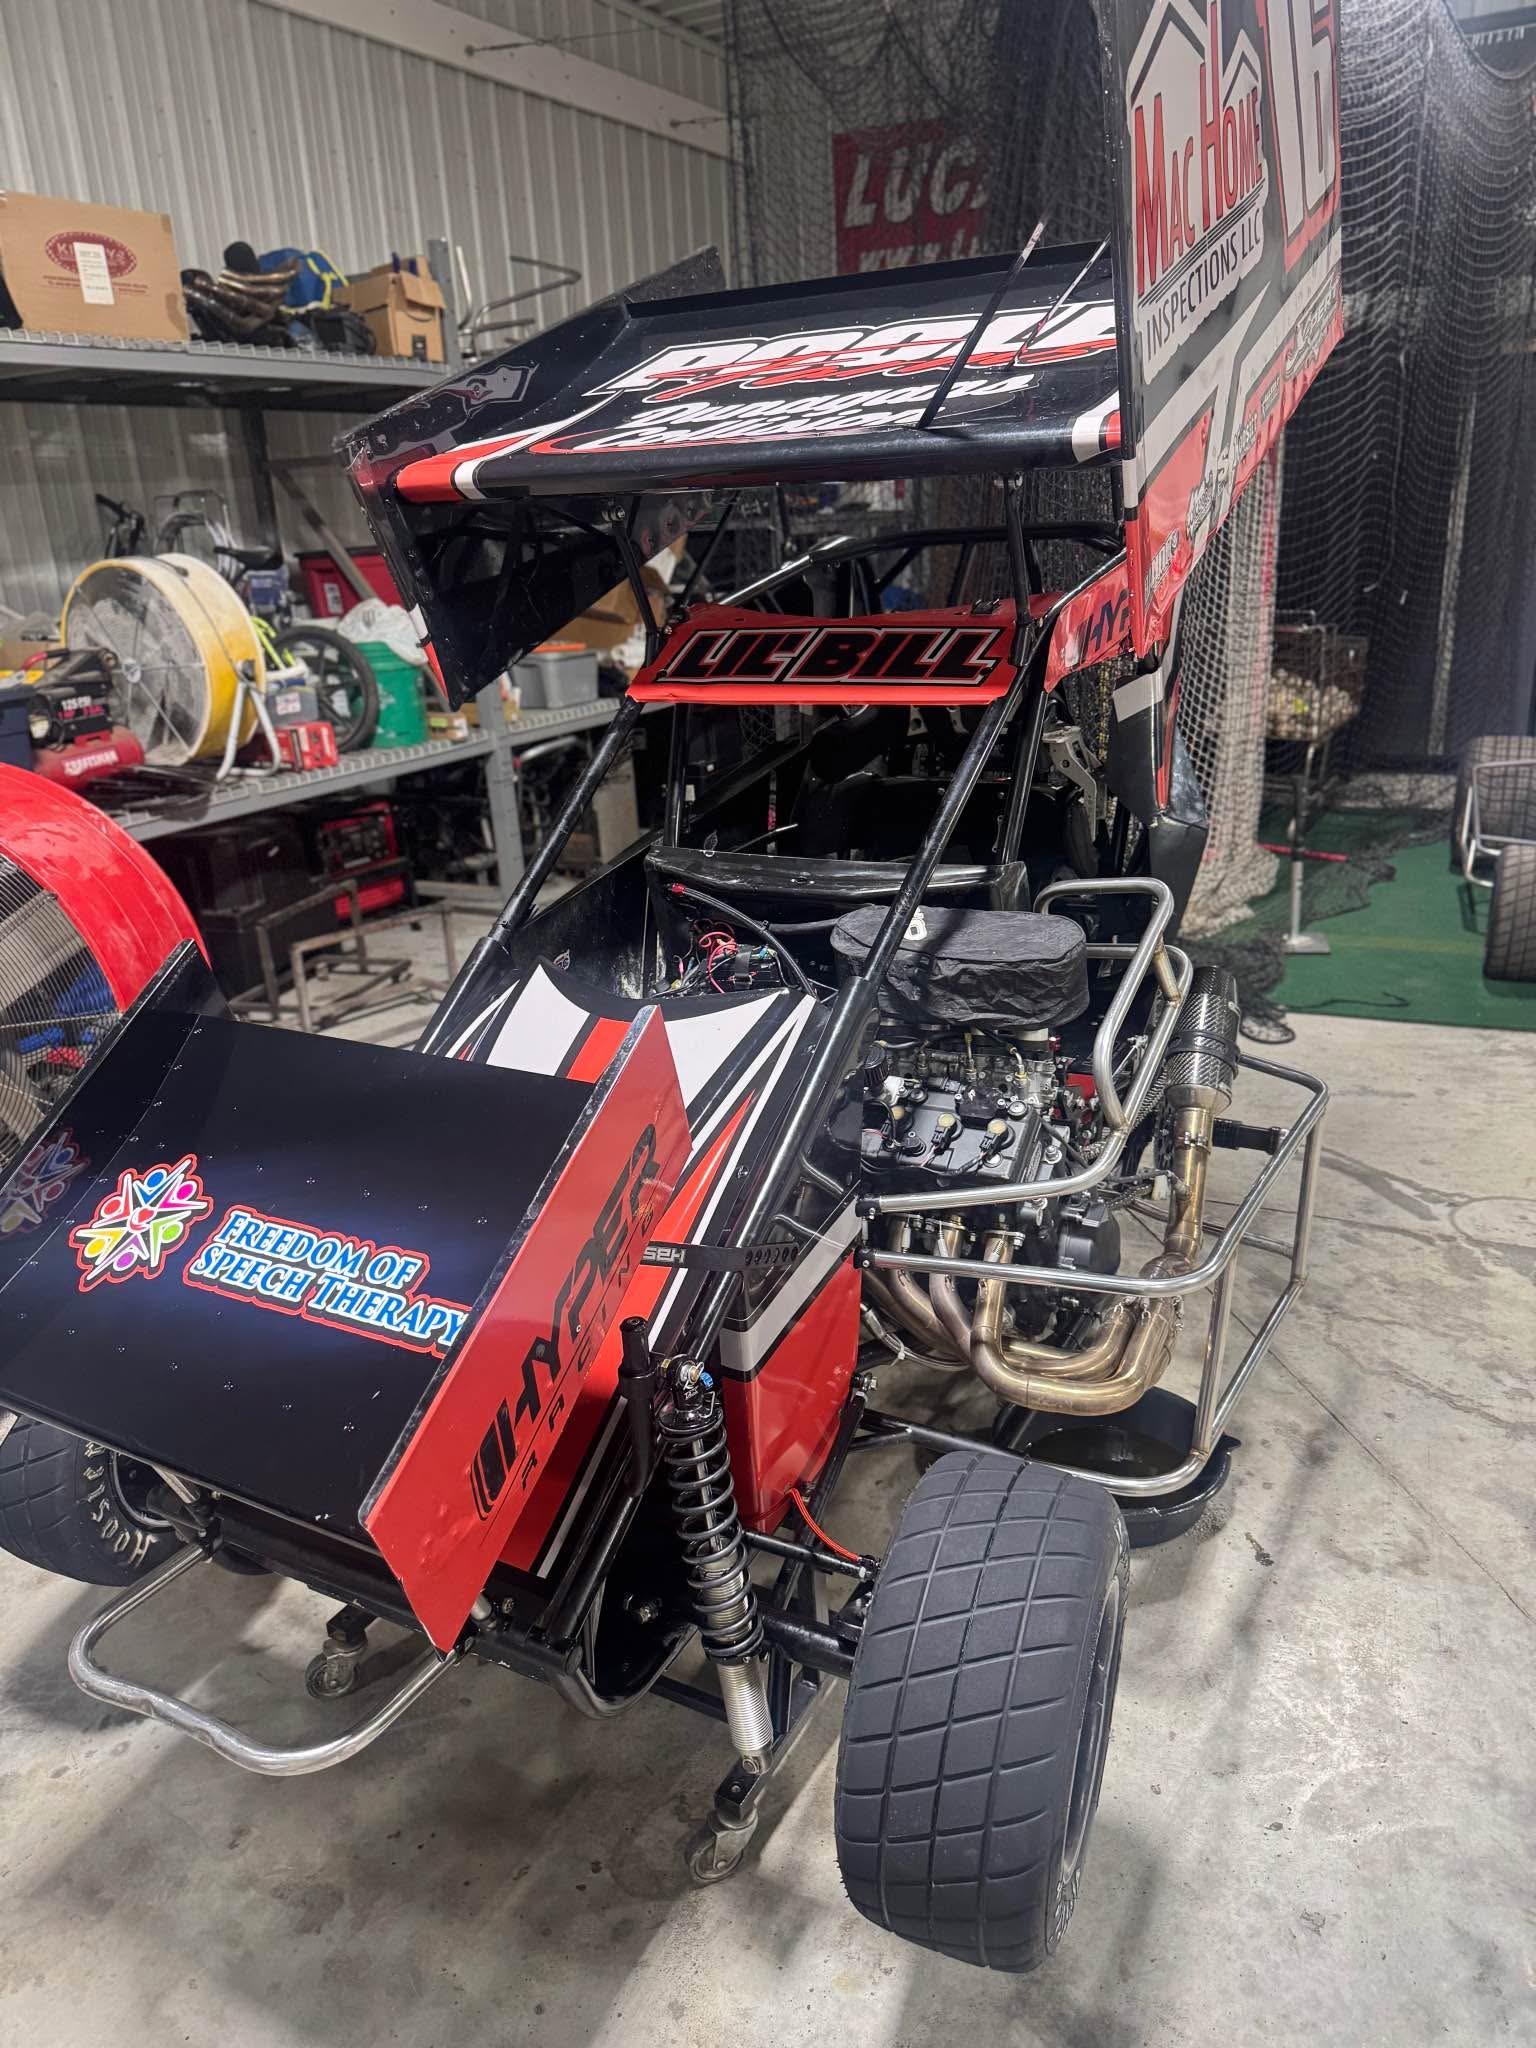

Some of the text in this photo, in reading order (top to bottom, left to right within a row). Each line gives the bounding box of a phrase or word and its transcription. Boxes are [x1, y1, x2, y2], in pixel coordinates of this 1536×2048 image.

[1146, 208, 1261, 362] INSPECTIONS LLC
[572, 405, 946, 451] Collision
[784, 628, 1000, 684] BILL
[195, 1243, 468, 1346] SPEECH THERAPY
[214, 1211, 423, 1290] FREEDOM OF
[521, 1208, 656, 1490] RACING
